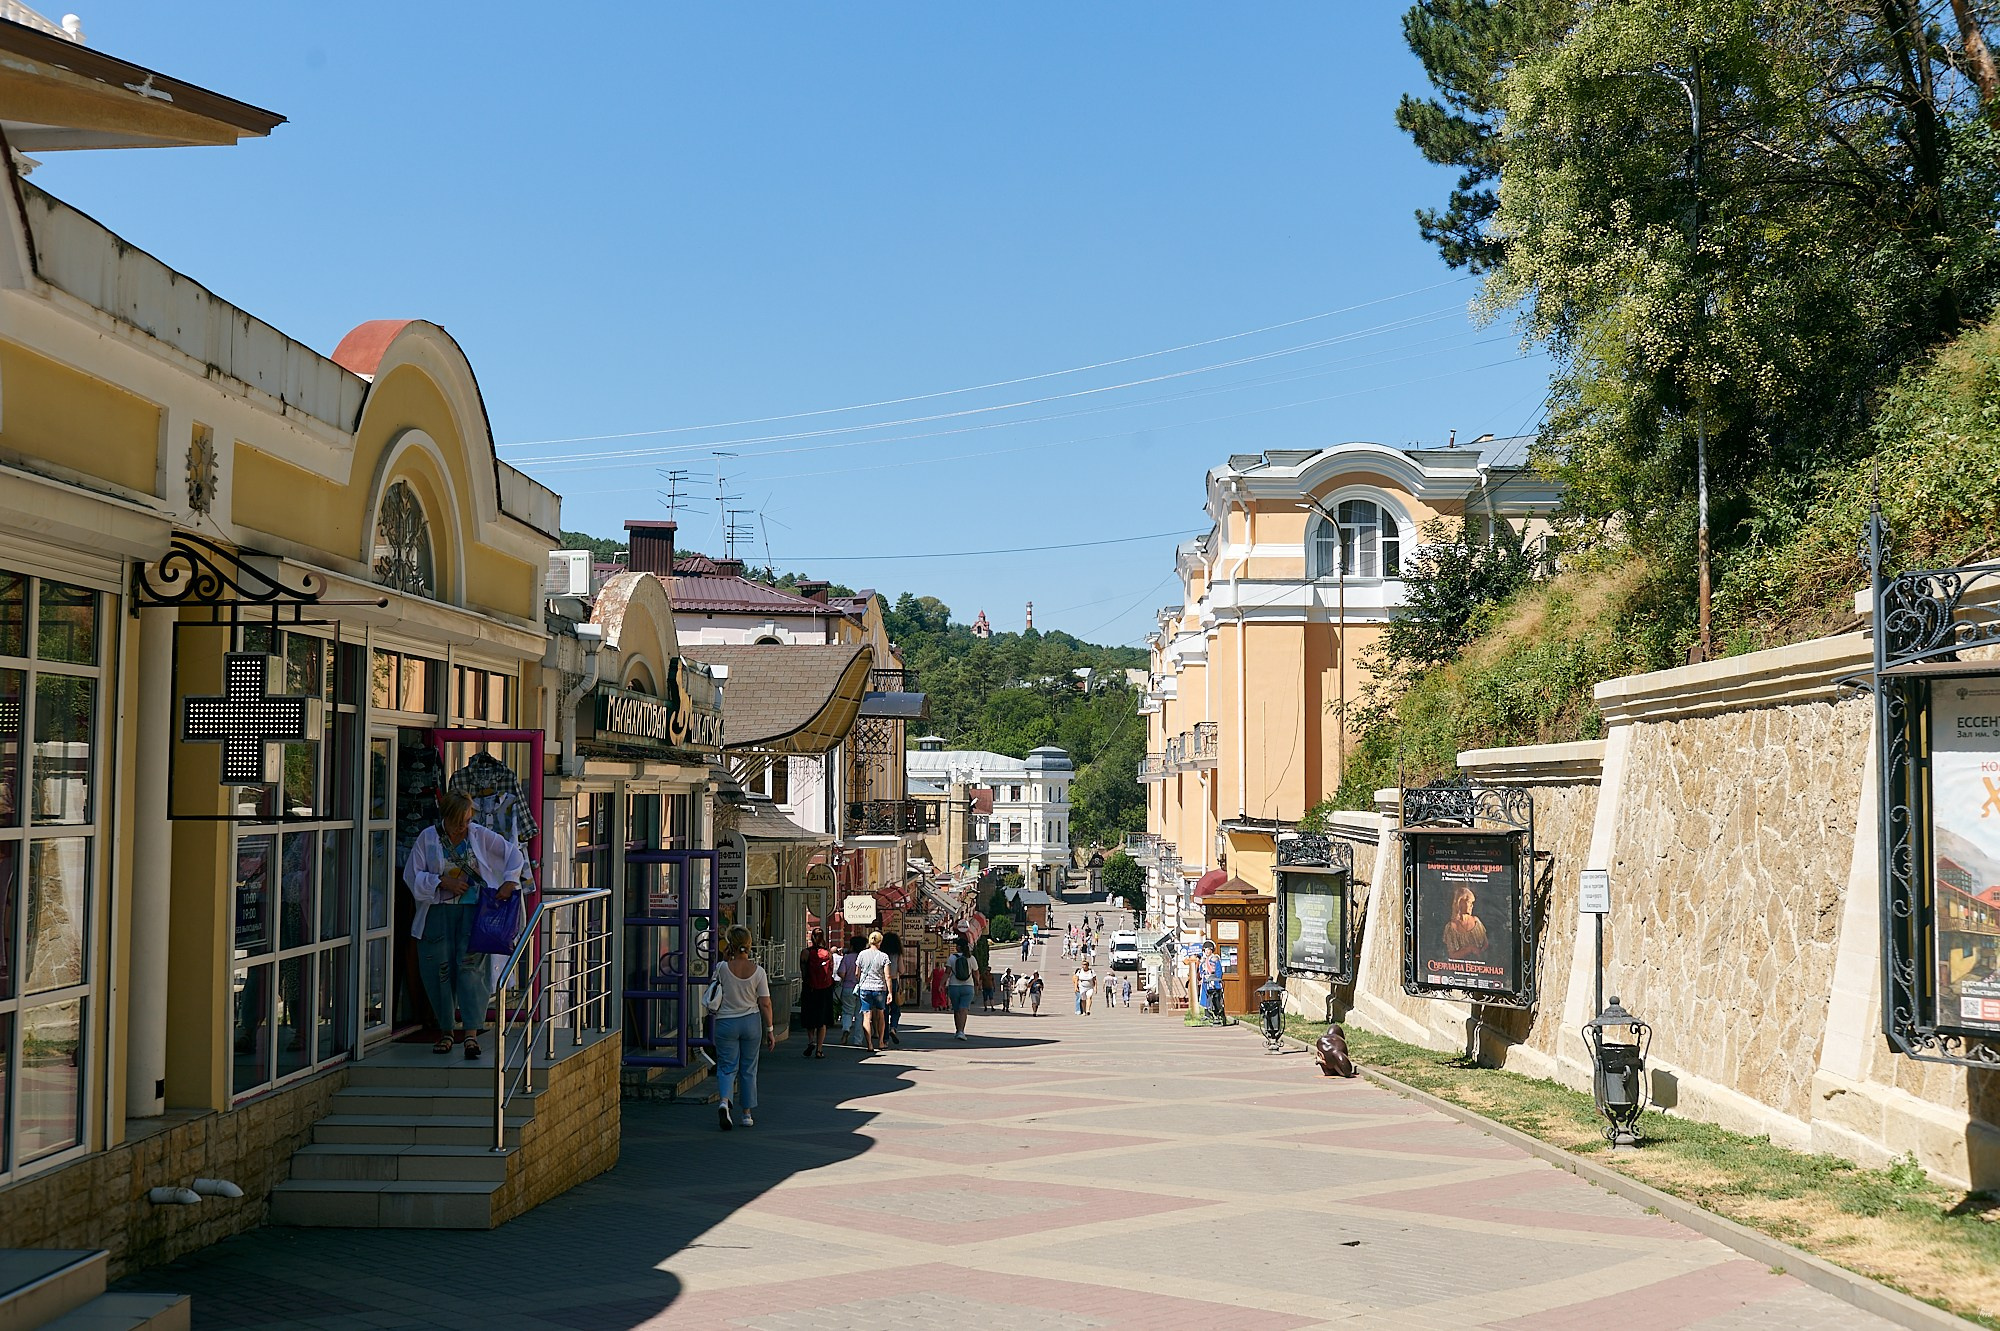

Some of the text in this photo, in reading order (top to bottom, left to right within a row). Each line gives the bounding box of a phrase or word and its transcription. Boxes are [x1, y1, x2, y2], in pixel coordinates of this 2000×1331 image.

[606, 694, 667, 740] МАЛАХИТОВАЯ
[1957, 716, 2000, 728] ЕССЕН
[1957, 730, 1973, 738] Зал
[1981, 761, 2000, 772] КО
[1428, 845, 1436, 856] 5
[848, 902, 872, 911] Зефир
[1427, 960, 1464, 972] СВЕТЛАНА
[1465, 964, 1504, 975] БЕРЕЖНАЯ
